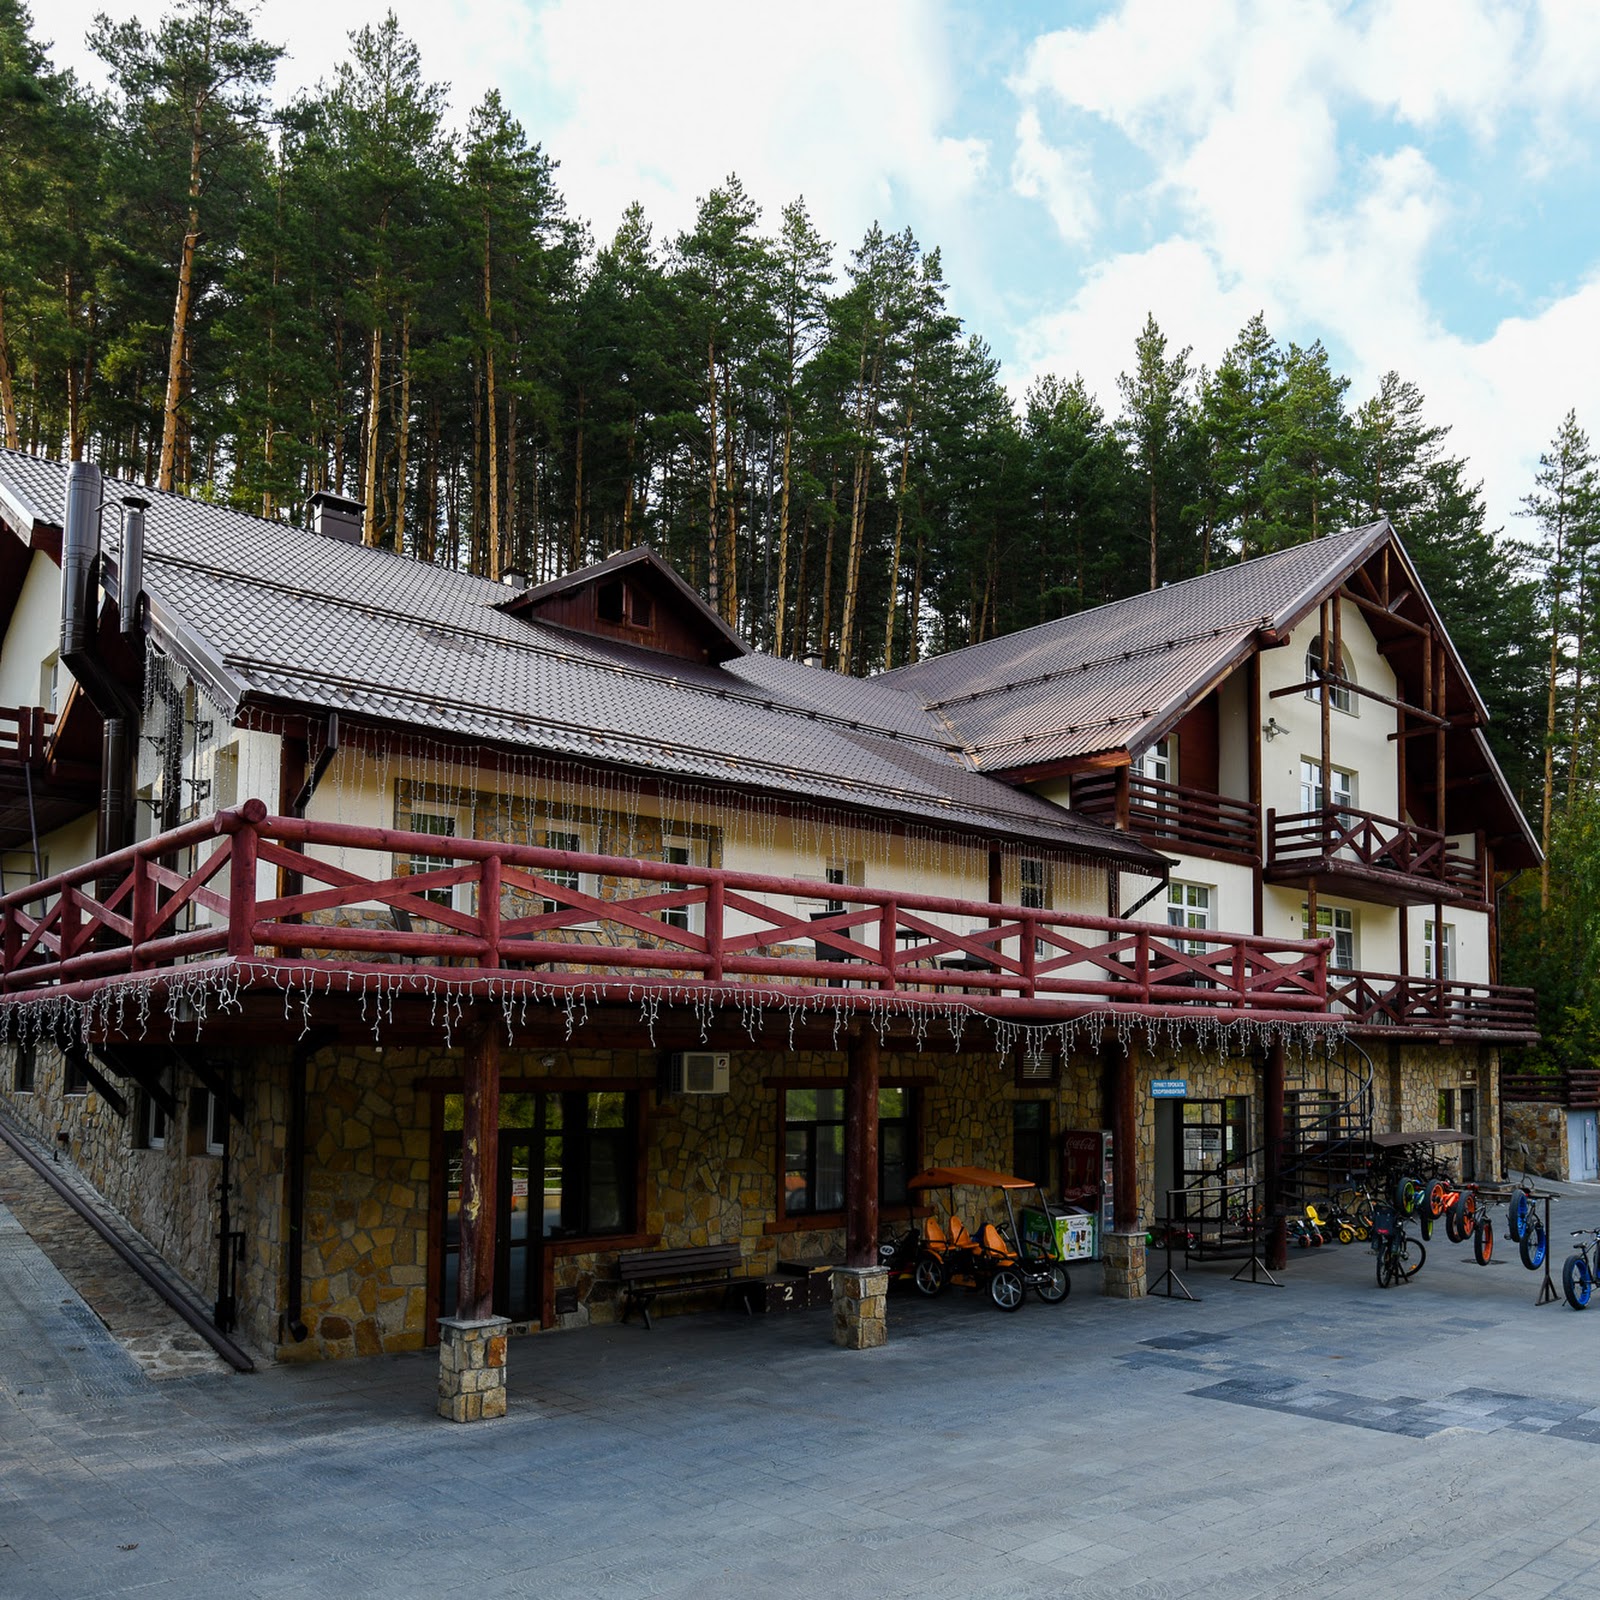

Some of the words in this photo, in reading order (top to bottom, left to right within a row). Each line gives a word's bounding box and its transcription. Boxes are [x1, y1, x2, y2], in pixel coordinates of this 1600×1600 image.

[1065, 1136, 1096, 1151] Coca-Cola
[828, 1272, 835, 1290] 1
[784, 1286, 794, 1301] 2
